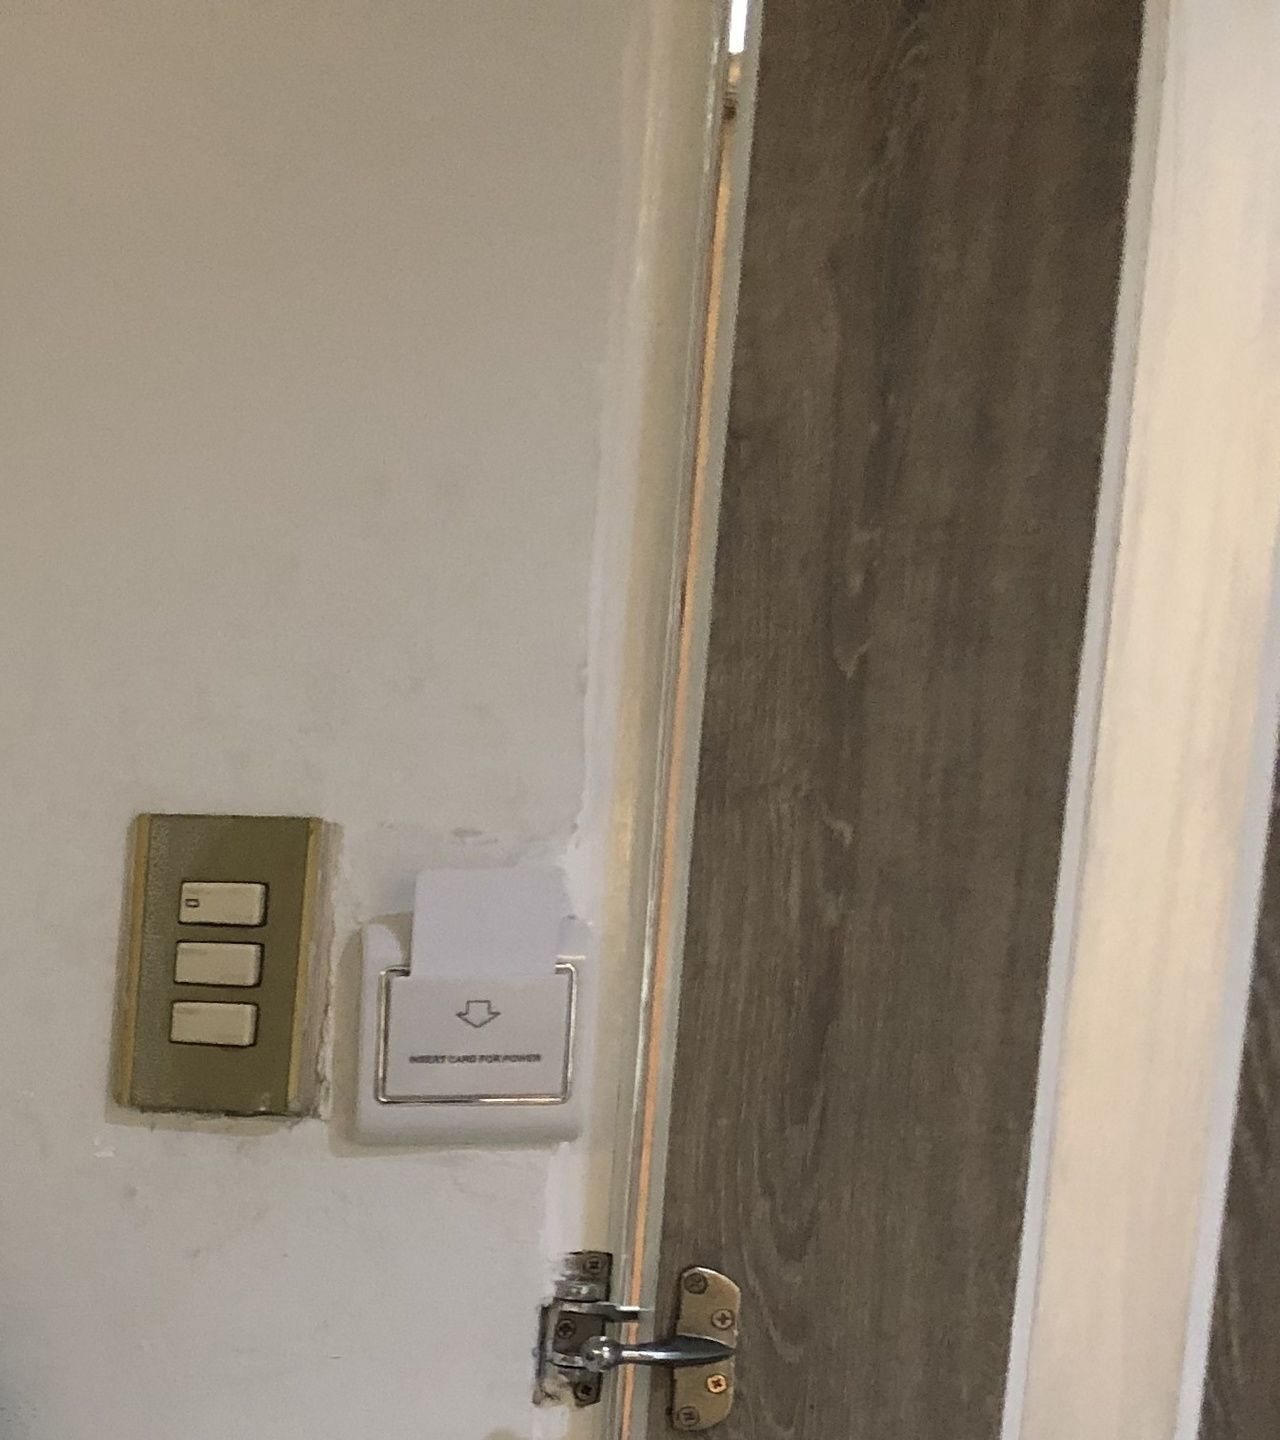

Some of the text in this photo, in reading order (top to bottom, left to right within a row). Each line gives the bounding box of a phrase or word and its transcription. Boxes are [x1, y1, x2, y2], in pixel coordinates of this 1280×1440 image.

[447, 1054, 477, 1064] CARD
[479, 1054, 501, 1063] FOR
[502, 1053, 542, 1063] POWER
